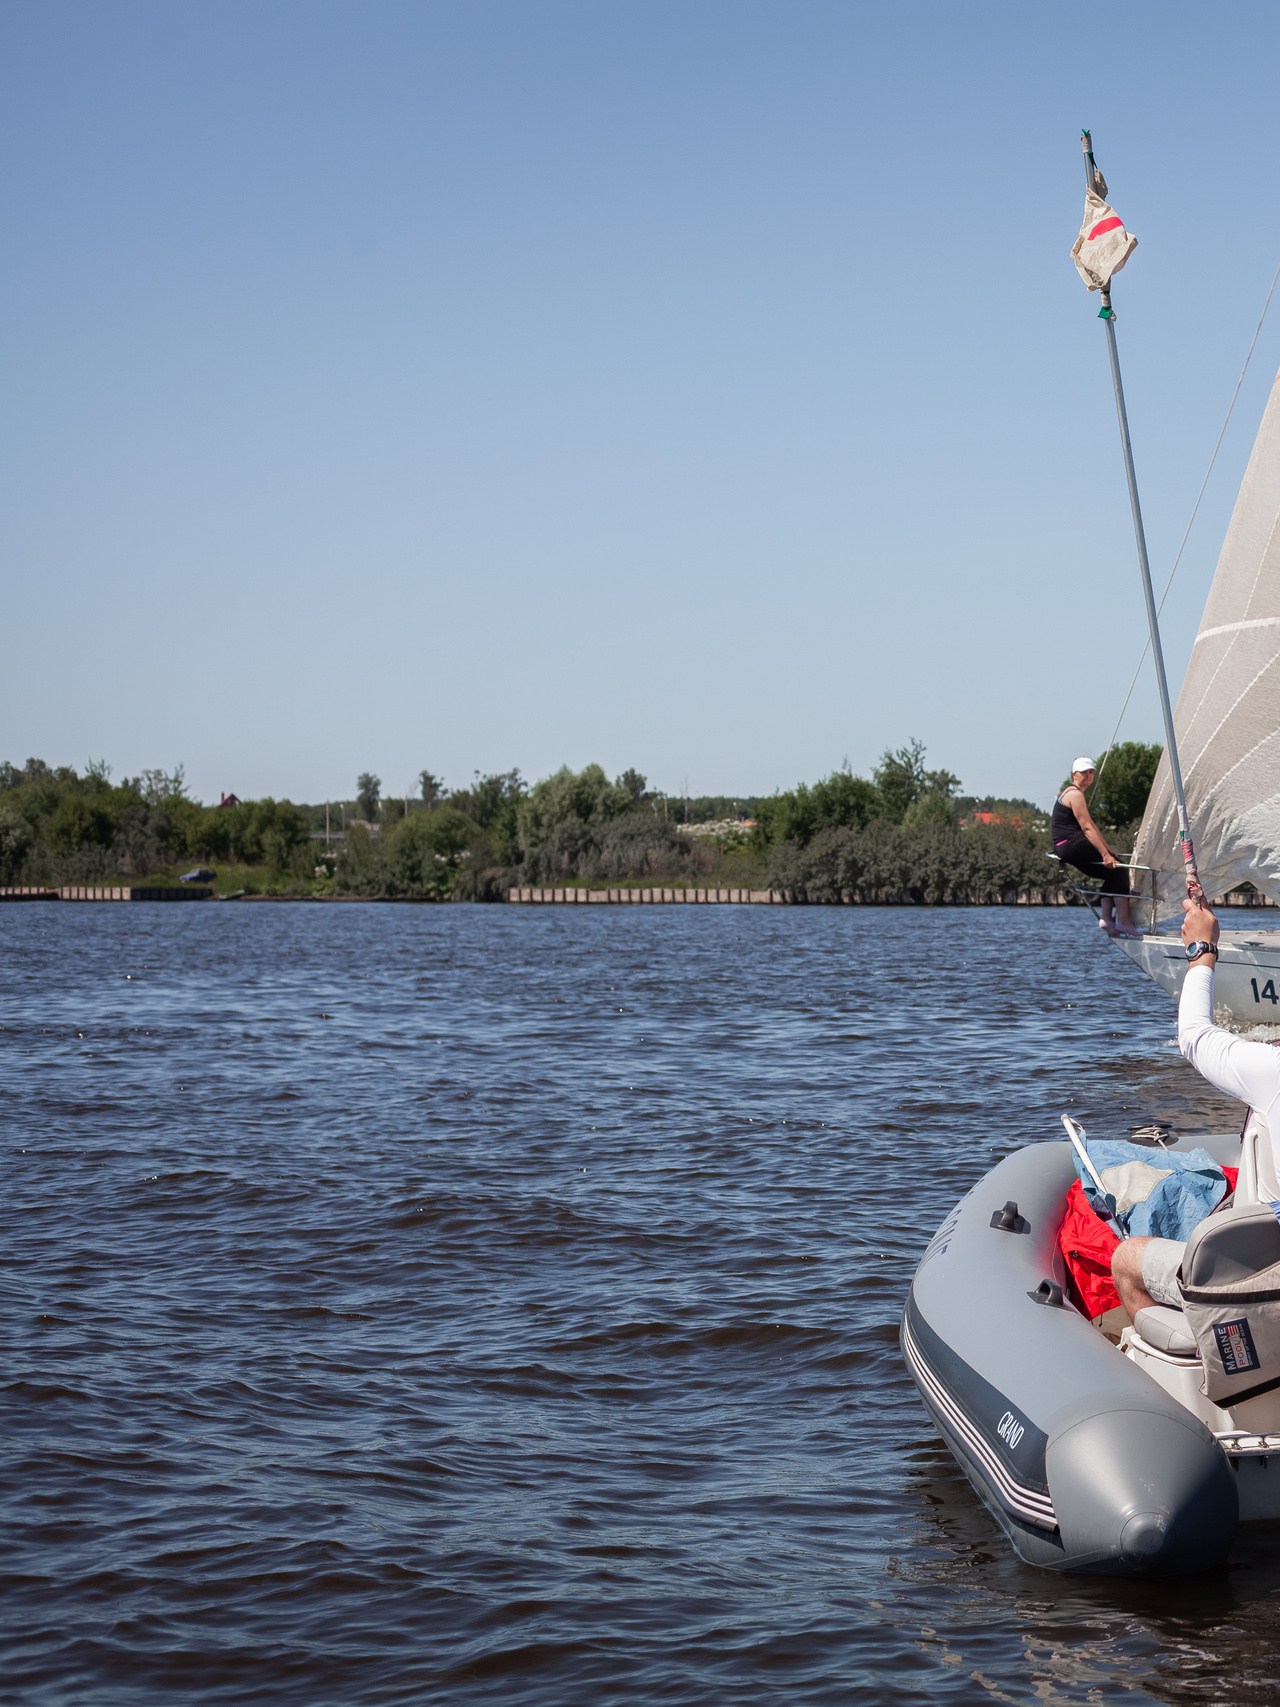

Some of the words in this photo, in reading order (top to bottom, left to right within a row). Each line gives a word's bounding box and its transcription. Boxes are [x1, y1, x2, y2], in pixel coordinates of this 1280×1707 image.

[1218, 1327, 1237, 1370] MARINE
[1235, 1340, 1246, 1366] POOL
[997, 1411, 1025, 1450] GRAND
